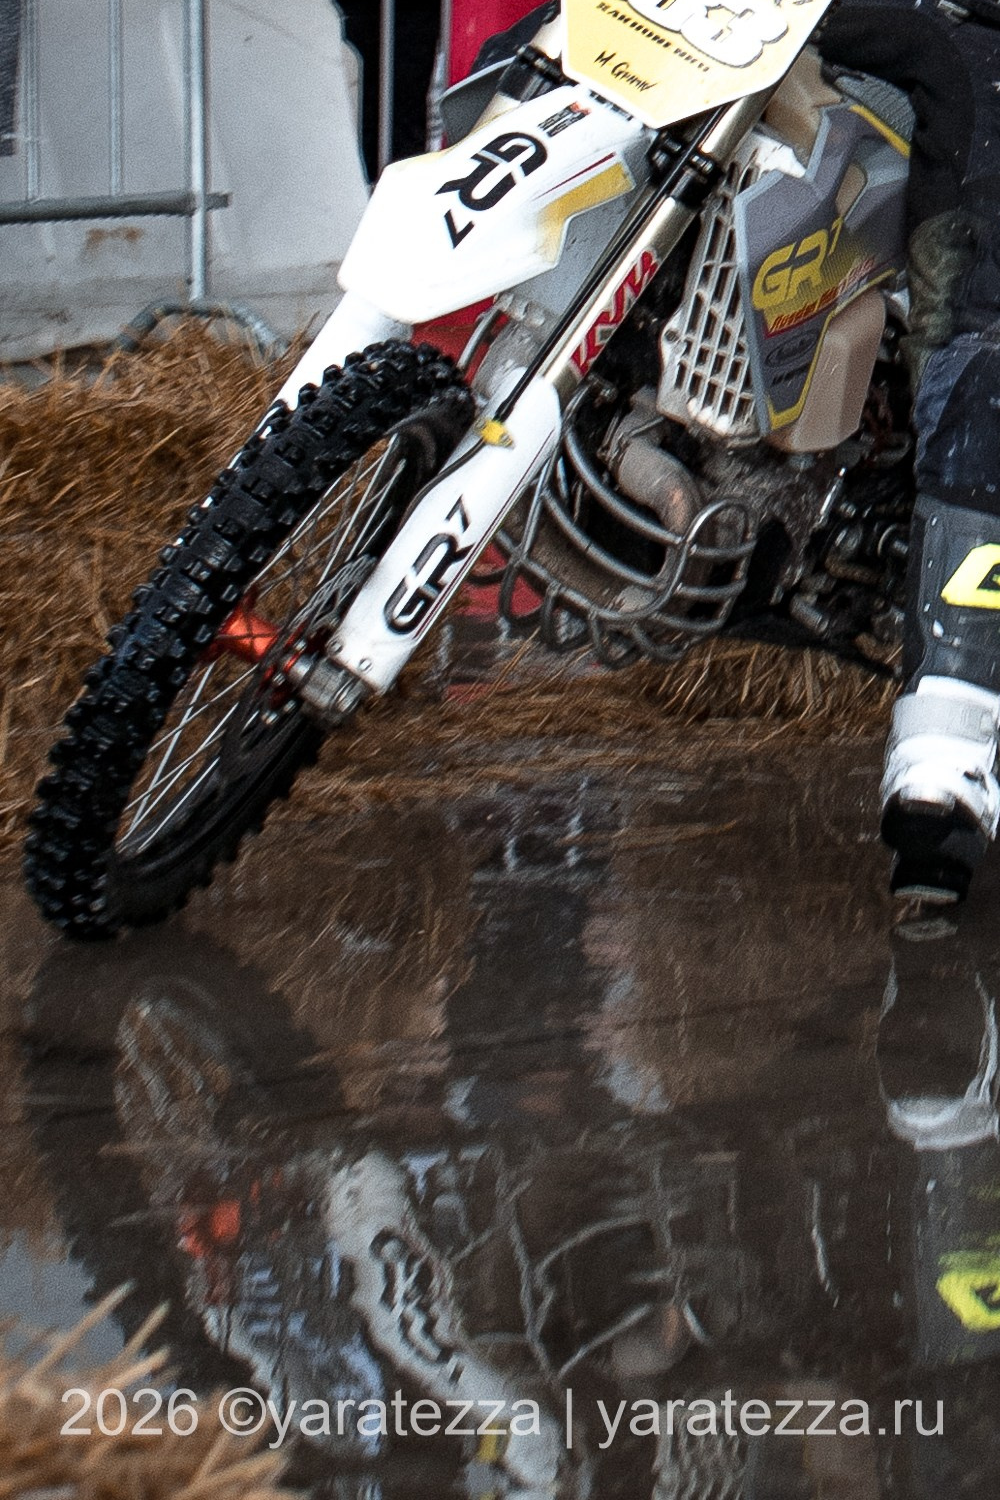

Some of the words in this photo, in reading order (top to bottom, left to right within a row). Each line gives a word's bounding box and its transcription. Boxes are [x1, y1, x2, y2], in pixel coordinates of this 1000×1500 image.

[434, 131, 549, 250] GR7
[571, 250, 659, 377] KYB
[752, 216, 844, 310] GR7
[383, 493, 477, 635] GR7
